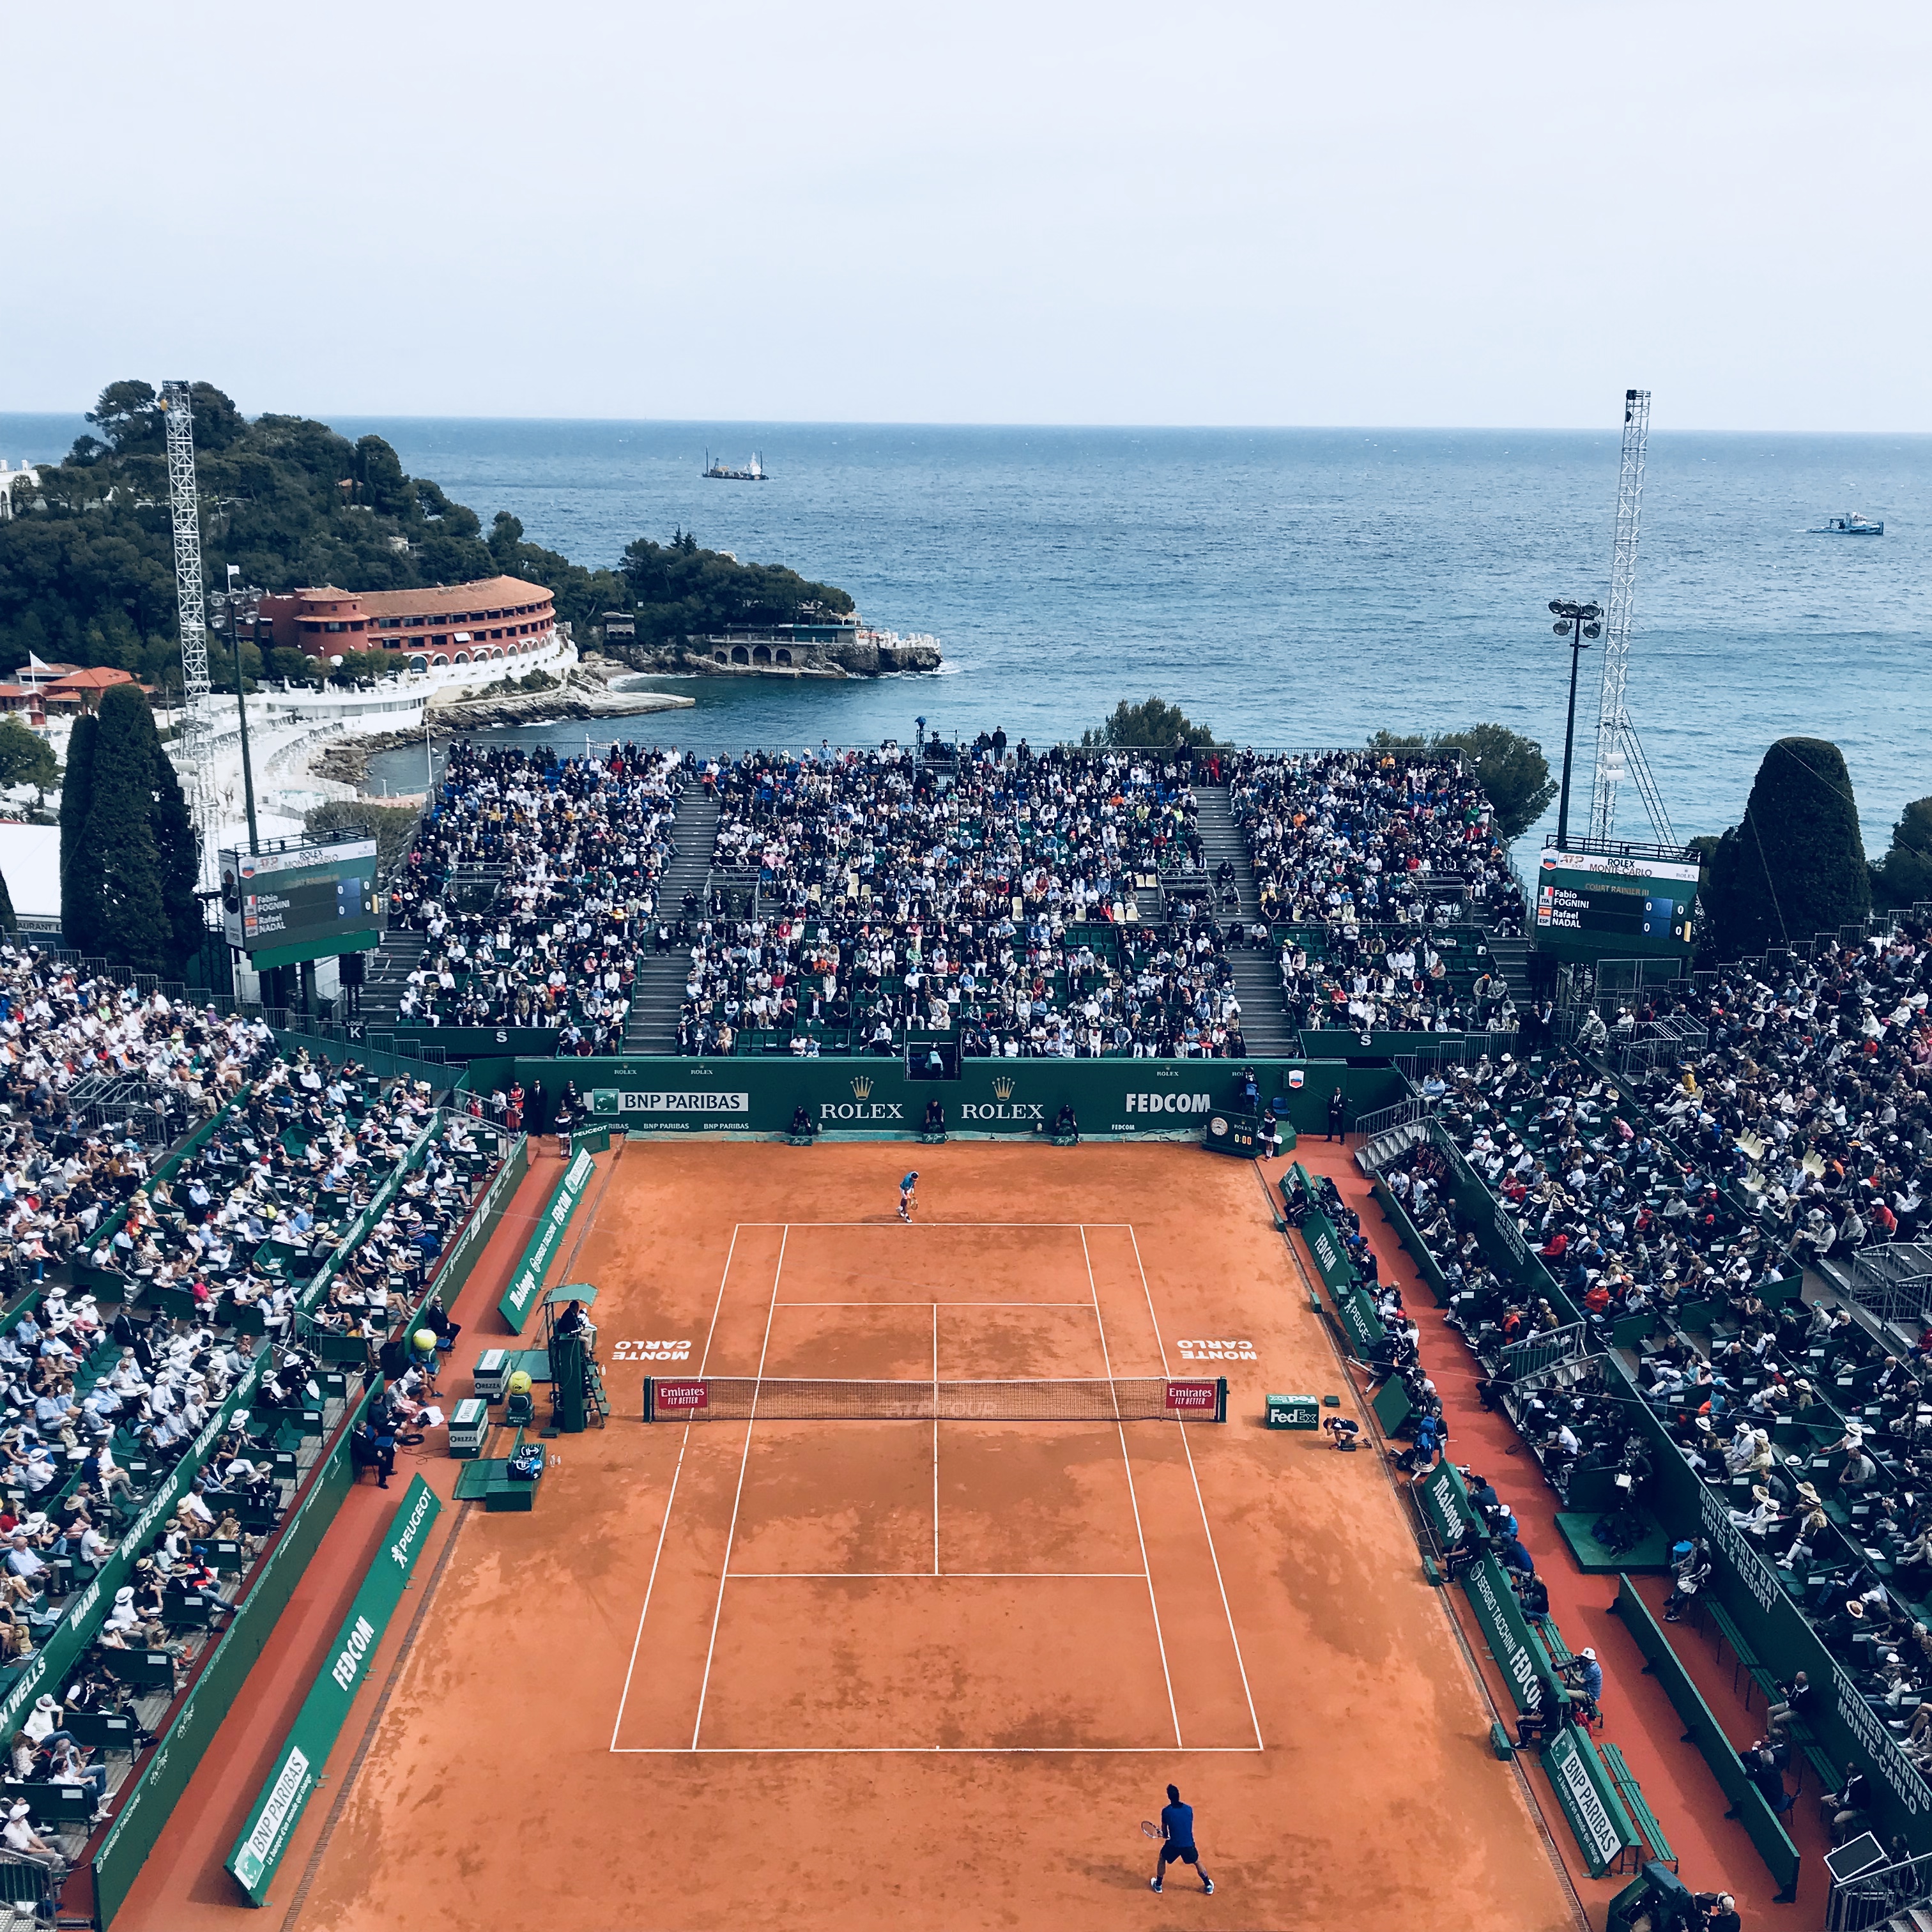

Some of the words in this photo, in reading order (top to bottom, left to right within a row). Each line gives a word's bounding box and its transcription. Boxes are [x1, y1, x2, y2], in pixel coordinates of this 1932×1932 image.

[300, 849, 323, 860] ROLEX
[1560, 855, 1584, 864] ATP
[1590, 863, 1652, 877] MONTE-CARLO
[1607, 858, 1635, 868] ROLEX
[1554, 889, 1577, 899] Fabio
[1585, 883, 1609, 893] COURT
[1611, 886, 1641, 895] RAINIER
[257, 894, 279, 904] Fabio
[257, 900, 290, 912] FOGNINI
[1554, 898, 1590, 908] FOGNINI
[1552, 910, 1579, 919] Rafael
[1645, 901, 1652, 911] 0
[1677, 905, 1684, 914] 0
[259, 922, 286, 933] NADAL
[1552, 918, 1581, 928] NADAL
[1644, 923, 1650, 932] 0
[1675, 926, 1682, 935] 0
[496, 1031, 507, 1043] S
[1360, 1034, 1372, 1046] S
[625, 1094, 661, 1108] BNP
[666, 1094, 740, 1109] PARIBAS
[1126, 1093, 1211, 1113] FEDCOM
[820, 1103, 904, 1119] ROLEX
[961, 1104, 1045, 1119] ROLEX
[572, 1124, 608, 1138] PEUGEOT
[1234, 1124, 1252, 1132] ROLEX
[1234, 1133, 1252, 1145] 0:00
[551, 1190, 573, 1225] FEDCOM
[1494, 1217, 1524, 1266] MONTE-CARLO
[1314, 1232, 1337, 1273] FEDCOM
[509, 1269, 537, 1311] Malongo
[1350, 1305, 1370, 1342] PEUGE
[615, 1340, 693, 1350] CARLO
[1177, 1340, 1254, 1349] CARLO
[611, 1351, 690, 1361] MONTE
[1181, 1350, 1257, 1360] MONTE
[238, 1366, 257, 1399] ROME
[660, 1386, 705, 1398] Emirates
[1169, 1387, 1213, 1399] Emirates
[667, 1397, 678, 1405] FLY
[678, 1397, 699, 1405] BETTER
[1174, 1397, 1186, 1405] FLY
[1186, 1397, 1206, 1405] BETTER
[1269, 1395, 1317, 1404] FedEx
[1270, 1409, 1317, 1423] FedEx
[194, 1412, 224, 1458] MADRID
[1432, 1475, 1465, 1539] Malongo
[121, 1475, 179, 1560] MONTE-CARLO
[400, 1487, 432, 1552] PEUGEOT
[1699, 1485, 1757, 1575] MONTE-CARLO
[1759, 1568, 1779, 1603] BAY
[1701, 1506, 1727, 1553] HOTEL
[1729, 1546, 1735, 1565] &
[1736, 1556, 1773, 1614] RESORT
[71, 1580, 100, 1631] MIAMI
[1476, 1575, 1496, 1611] SERGIO
[1492, 1606, 1517, 1654] TACCHINI
[332, 1615, 375, 1691] FEDCOM
[9, 1656, 47, 1715] WELLS
[1832, 1666, 1882, 1745] THERMES
[1884, 1738, 1930, 1812] MARINS
[1837, 1696, 1917, 1816] MONTE-CARLO
[252, 1816, 273, 1854] BNP
[268, 1757, 303, 1821] PARIBAS
[1565, 1756, 1586, 1788] BNP
[1579, 1786, 1616, 1853] PARIBAS
[1575, 1813, 1586, 1834] monde
[1583, 1832, 1591, 1844] qui
[1588, 1843, 1600, 1865] change
